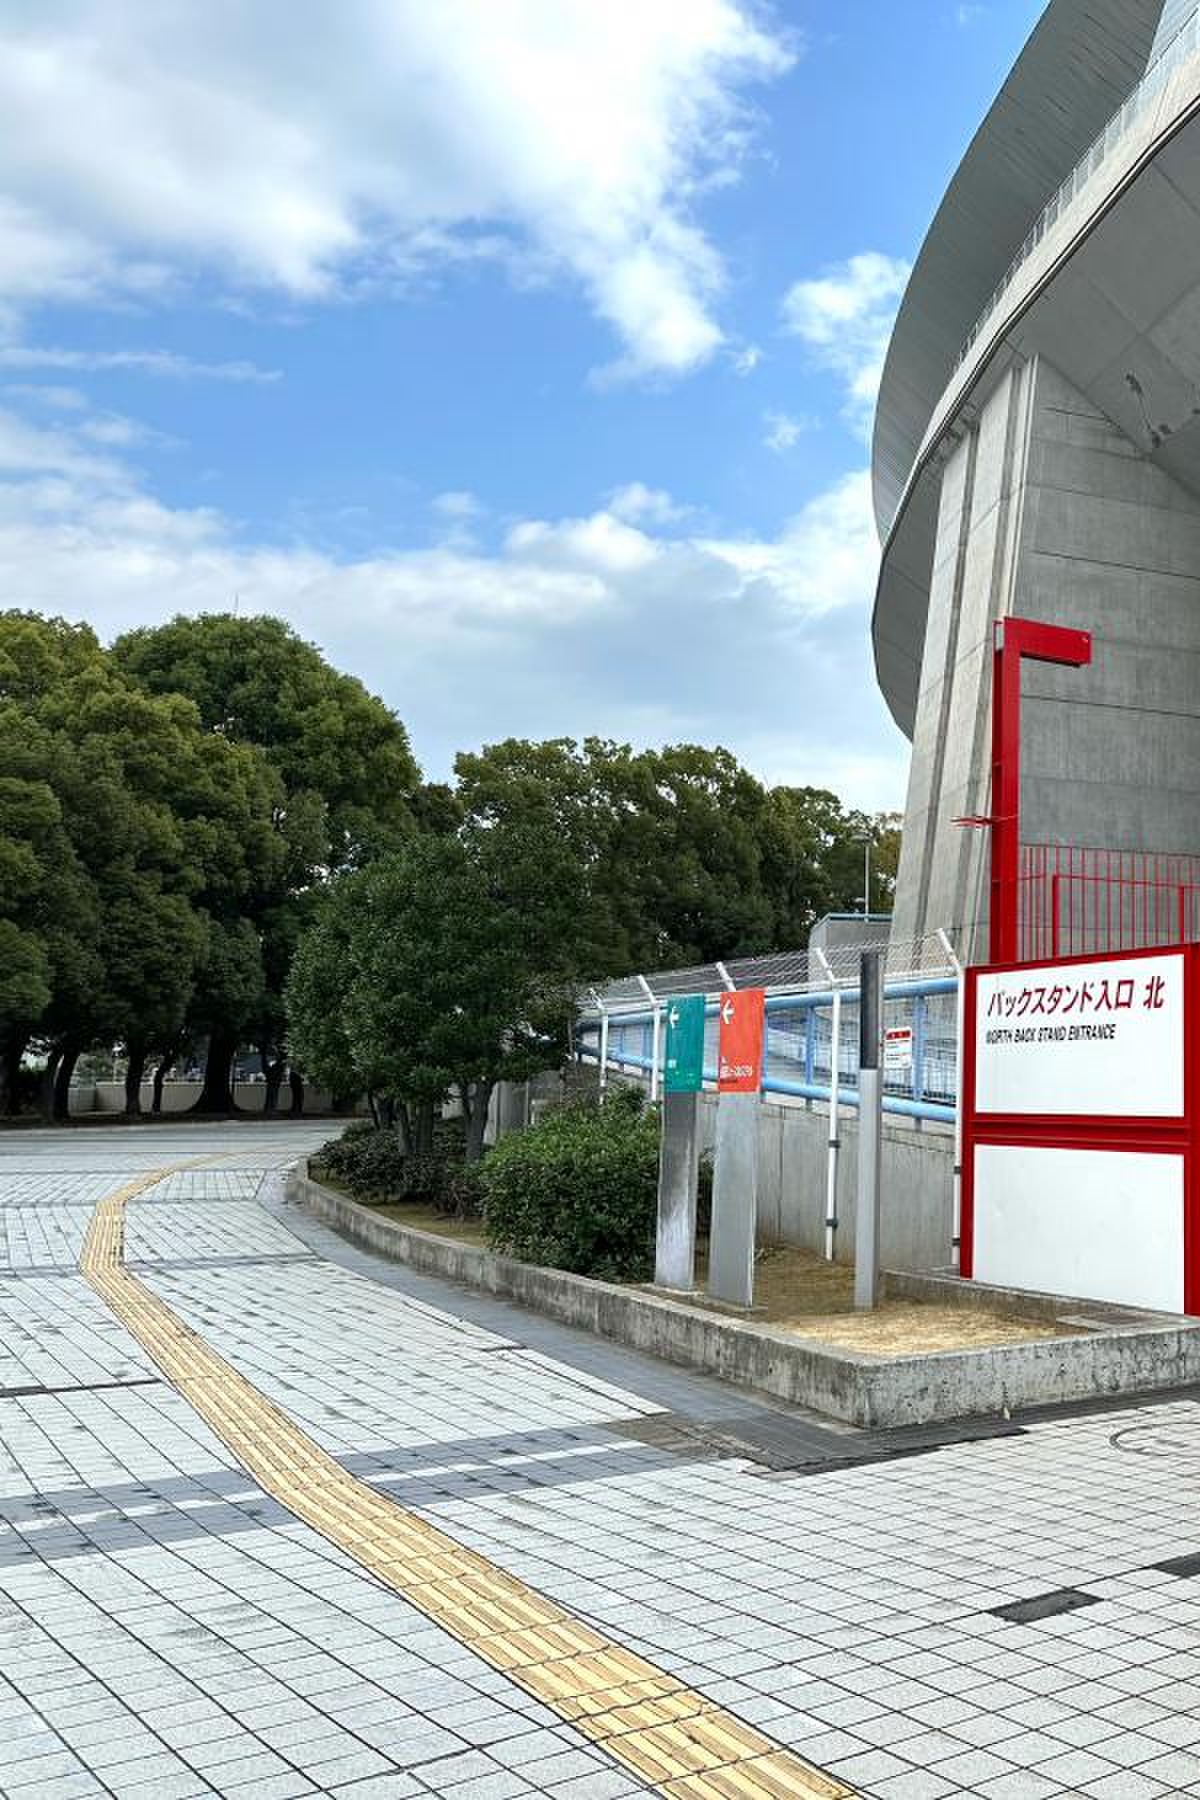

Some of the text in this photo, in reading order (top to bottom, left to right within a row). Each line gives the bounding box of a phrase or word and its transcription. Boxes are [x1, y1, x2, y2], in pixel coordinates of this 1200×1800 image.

[987, 975, 1165, 1017] バックスタンド入口 北
[986, 1023, 1117, 1044] NORTH BACK STAND ENTRANCE
